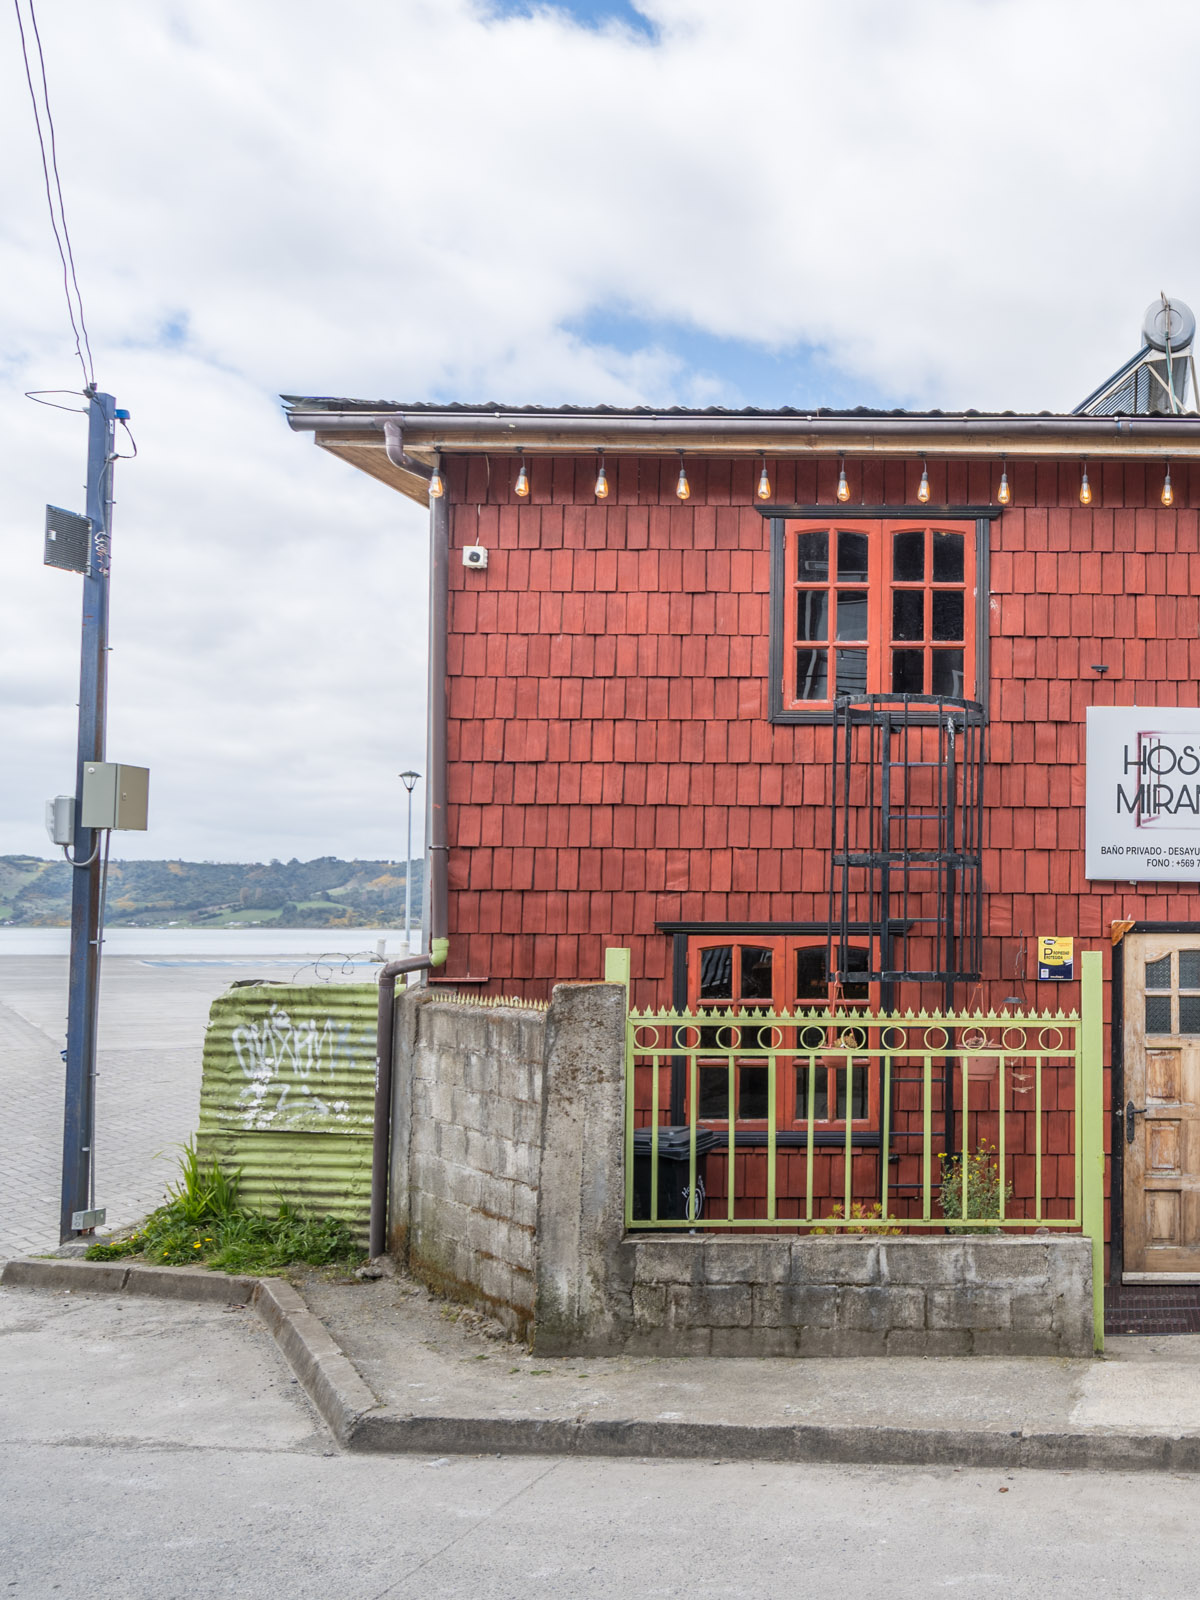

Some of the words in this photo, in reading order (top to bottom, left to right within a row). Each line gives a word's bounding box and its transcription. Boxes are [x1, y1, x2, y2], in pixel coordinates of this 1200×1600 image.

[1100, 845, 1124, 855] BAÑO
[1126, 846, 1162, 855] PRIVADO
[1146, 858, 1170, 867] FONO
[1176, 859, 1195, 868] +569
